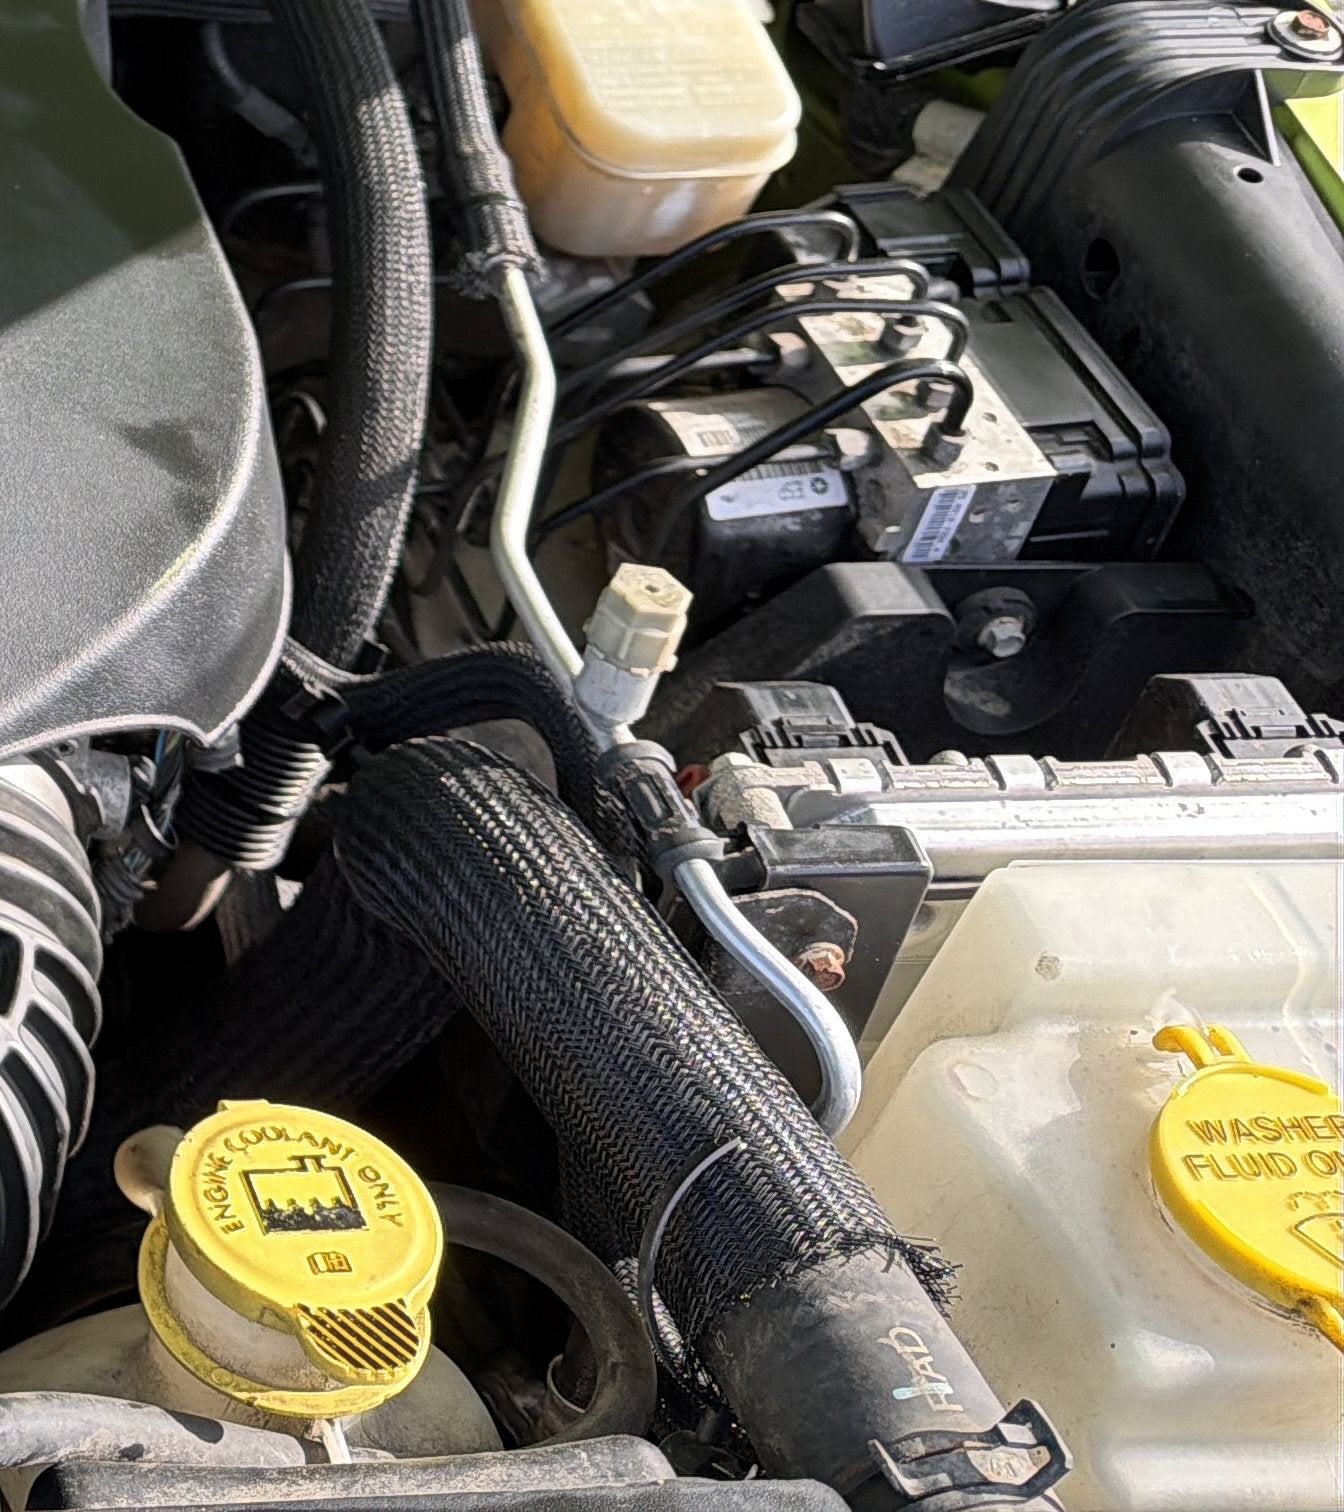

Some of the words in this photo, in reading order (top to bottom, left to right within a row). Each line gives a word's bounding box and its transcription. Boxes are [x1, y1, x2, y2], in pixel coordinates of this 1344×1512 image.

[223, 1125, 359, 1161] COOLANT
[1181, 1151, 1299, 1182] FLUID
[202, 1152, 246, 1235] ENGINE
[357, 1164, 405, 1228] ONLY
